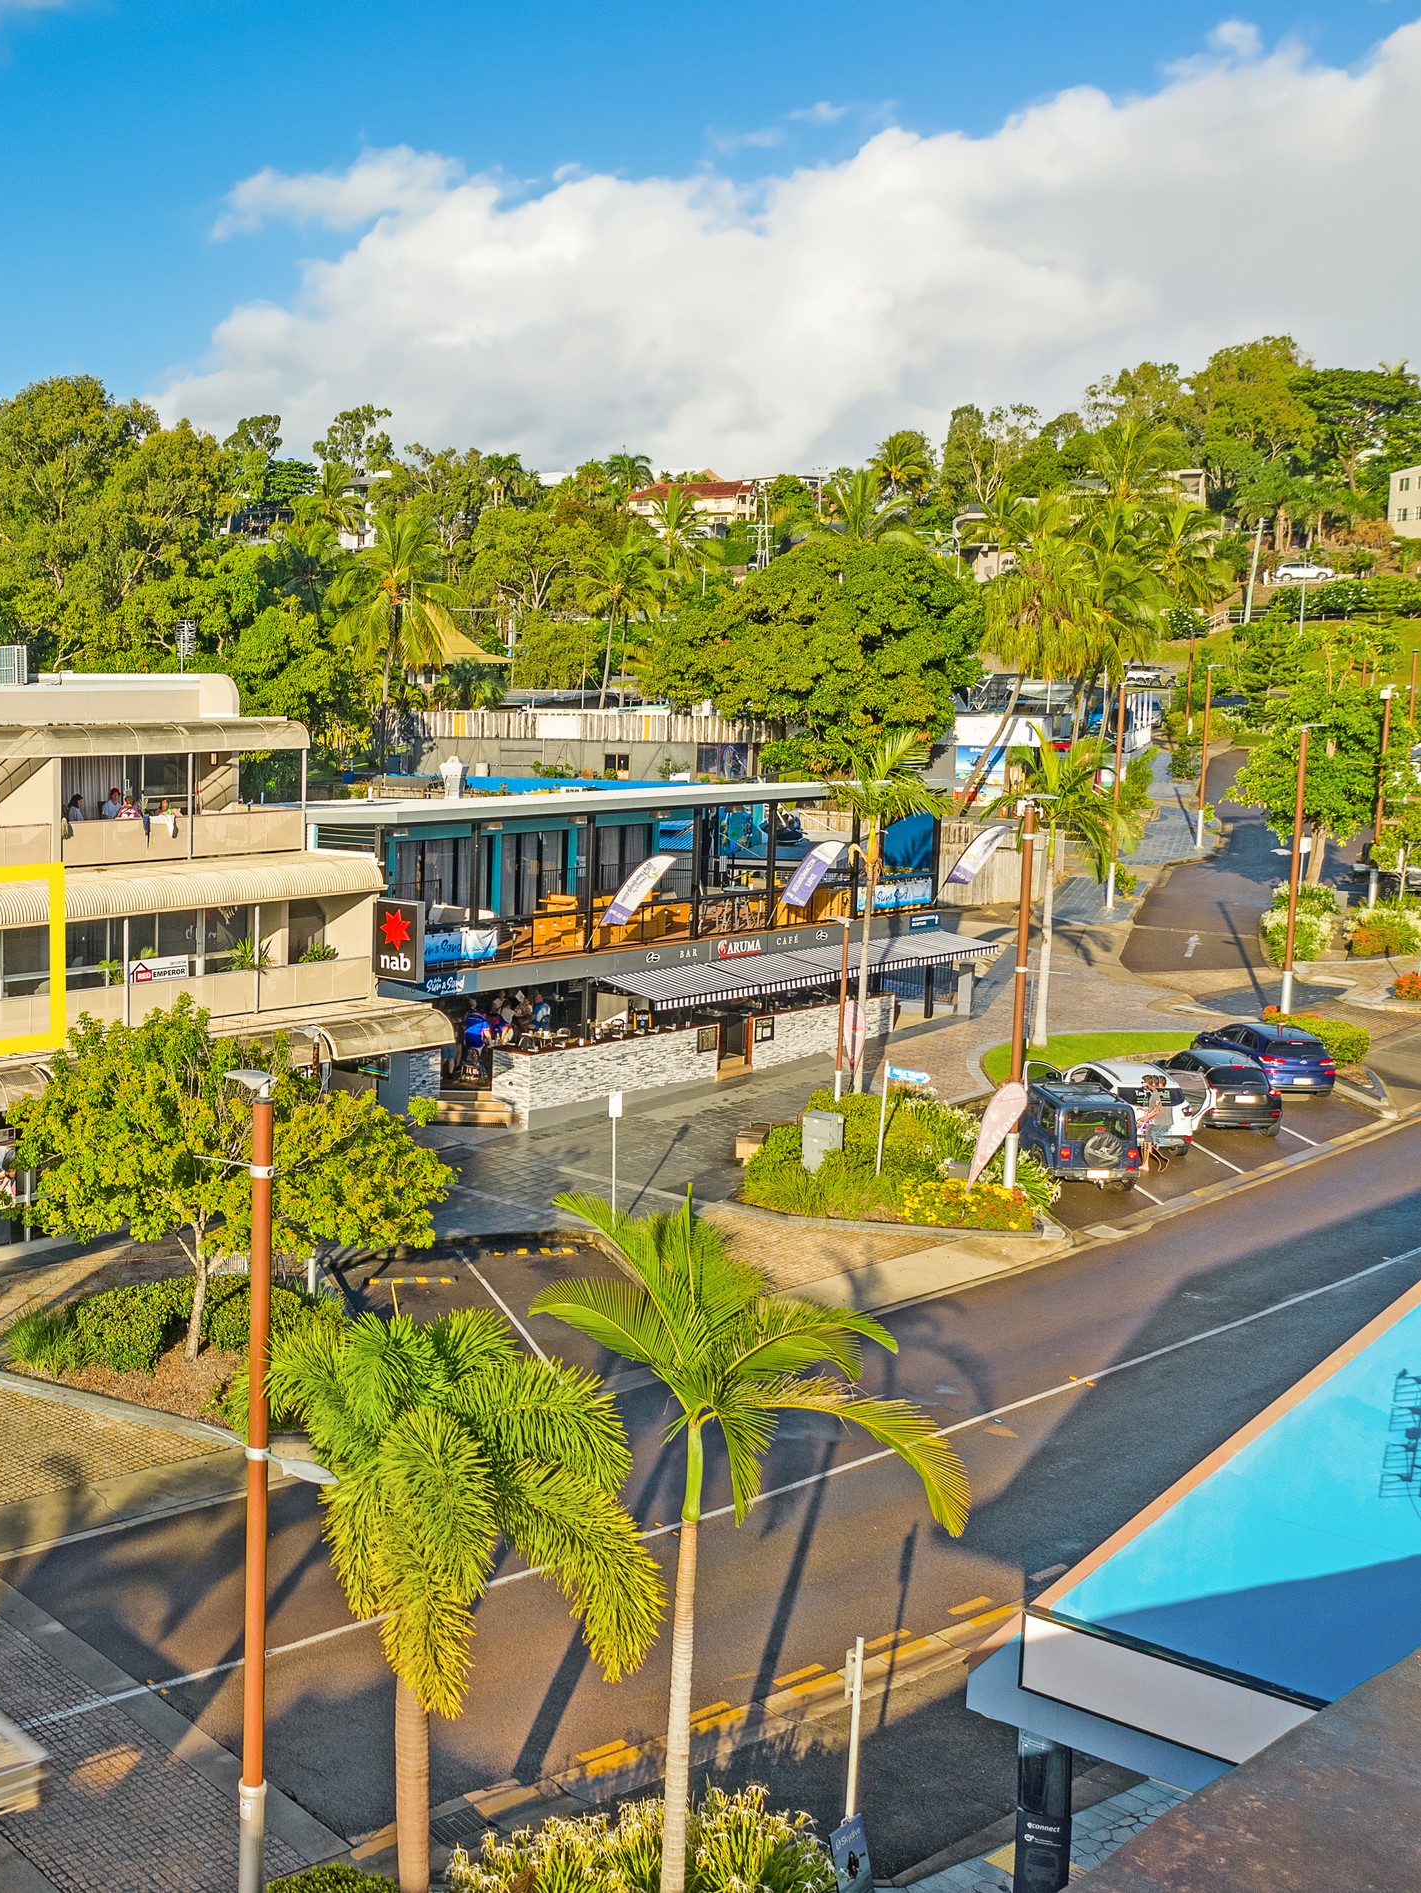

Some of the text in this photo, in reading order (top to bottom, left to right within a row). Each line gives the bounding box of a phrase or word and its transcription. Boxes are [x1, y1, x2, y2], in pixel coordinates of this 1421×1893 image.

[776, 934, 800, 946] CAFÉ
[679, 949, 698, 959] BAR
[380, 953, 411, 972] nab
[153, 968, 186, 978] EMPEROR
[426, 979, 441, 993] Sun
[977, 1111, 1018, 1164] Coffee
